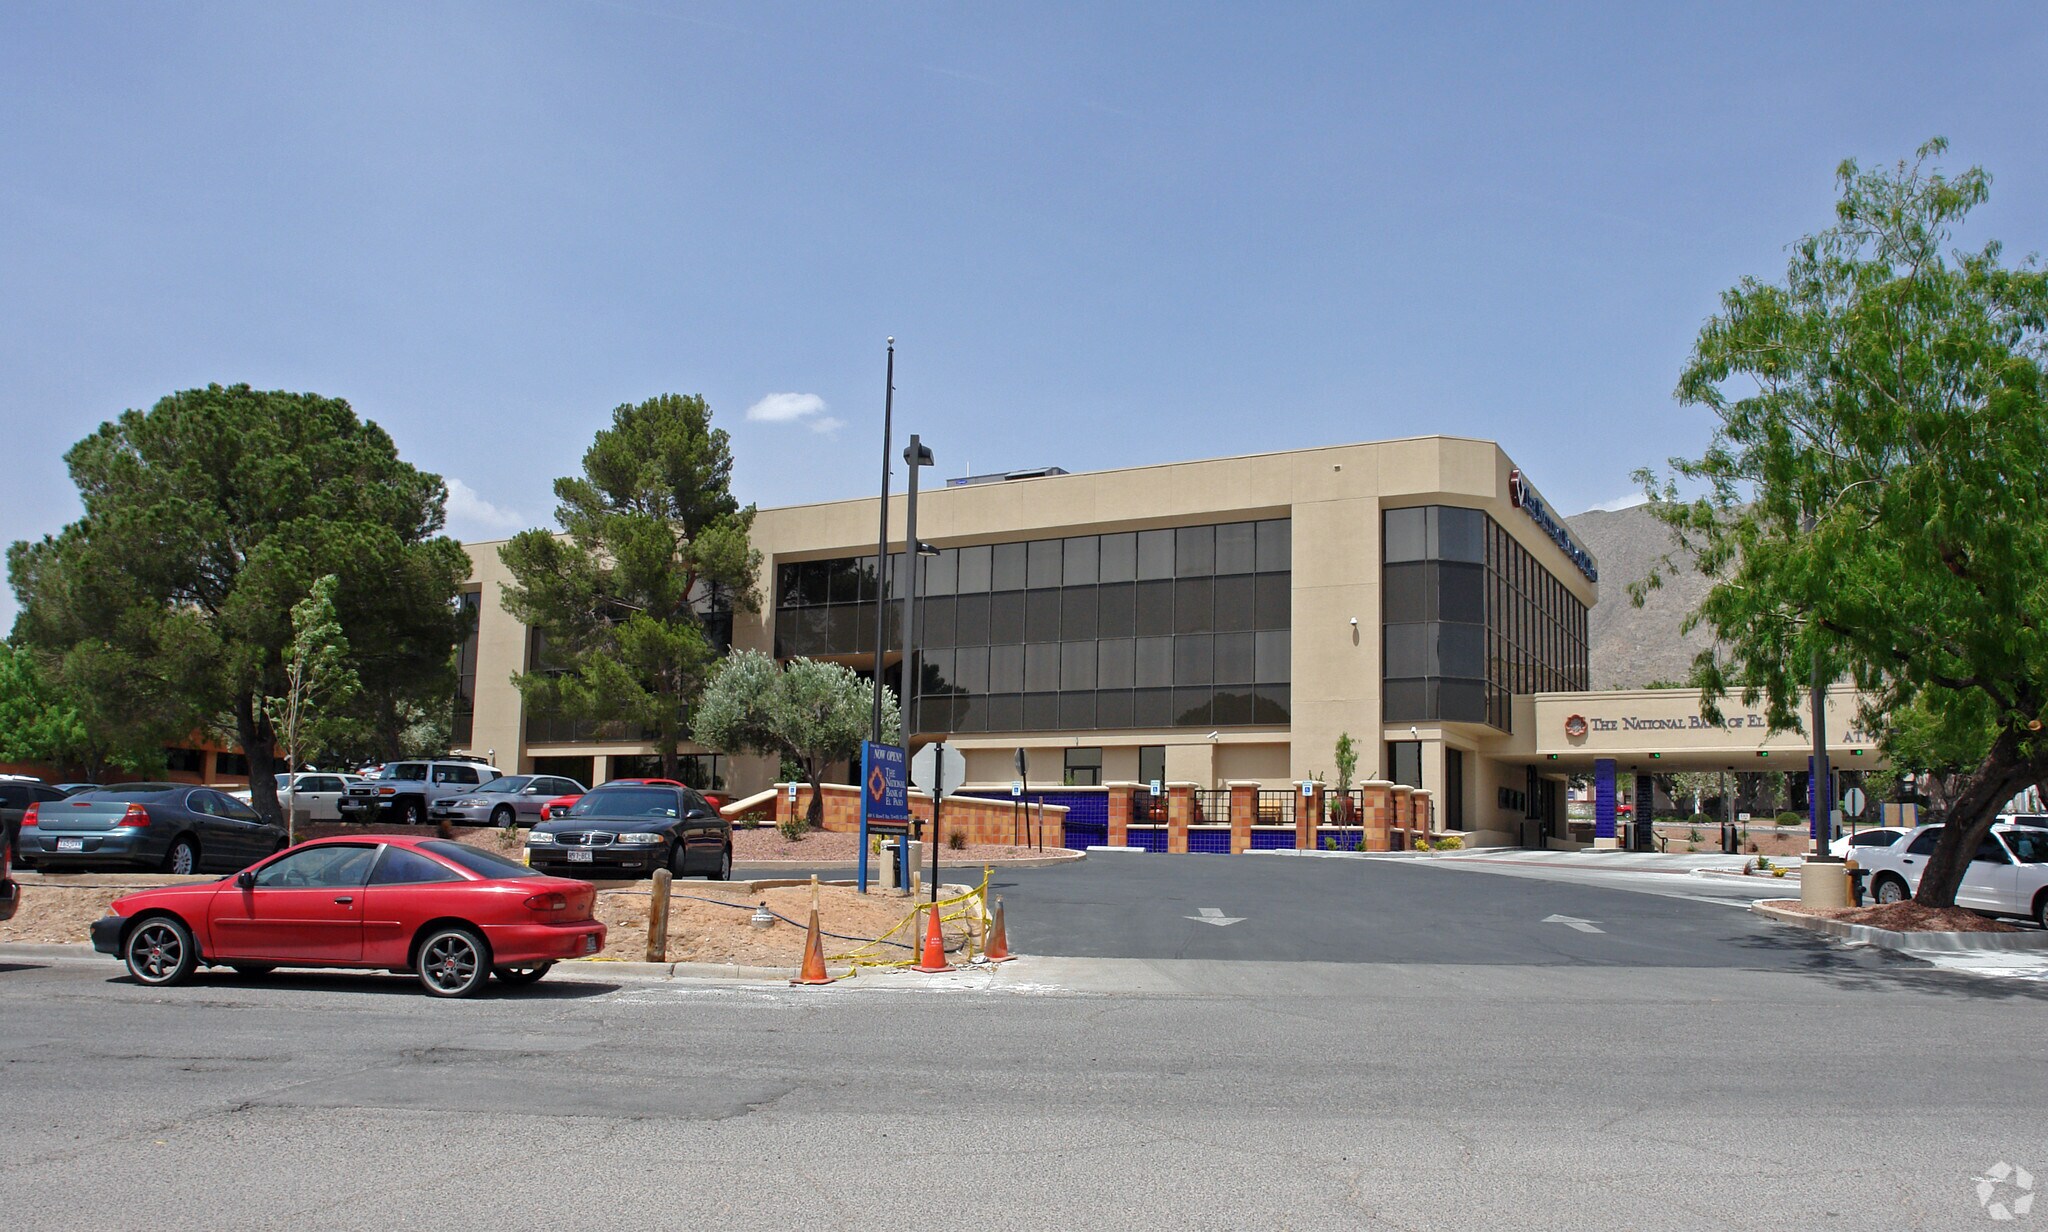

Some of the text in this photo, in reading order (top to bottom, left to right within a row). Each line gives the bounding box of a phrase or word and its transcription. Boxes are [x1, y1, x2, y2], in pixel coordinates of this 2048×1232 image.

[1590, 718, 1617, 731] THE
[1622, 716, 1686, 730] NATIONAL
[1688, 715, 1726, 729] BA
[1728, 717, 1744, 728] OF
[1747, 714, 1765, 727] EL
[874, 749, 886, 760] NOW
[885, 768, 895, 778] THE
